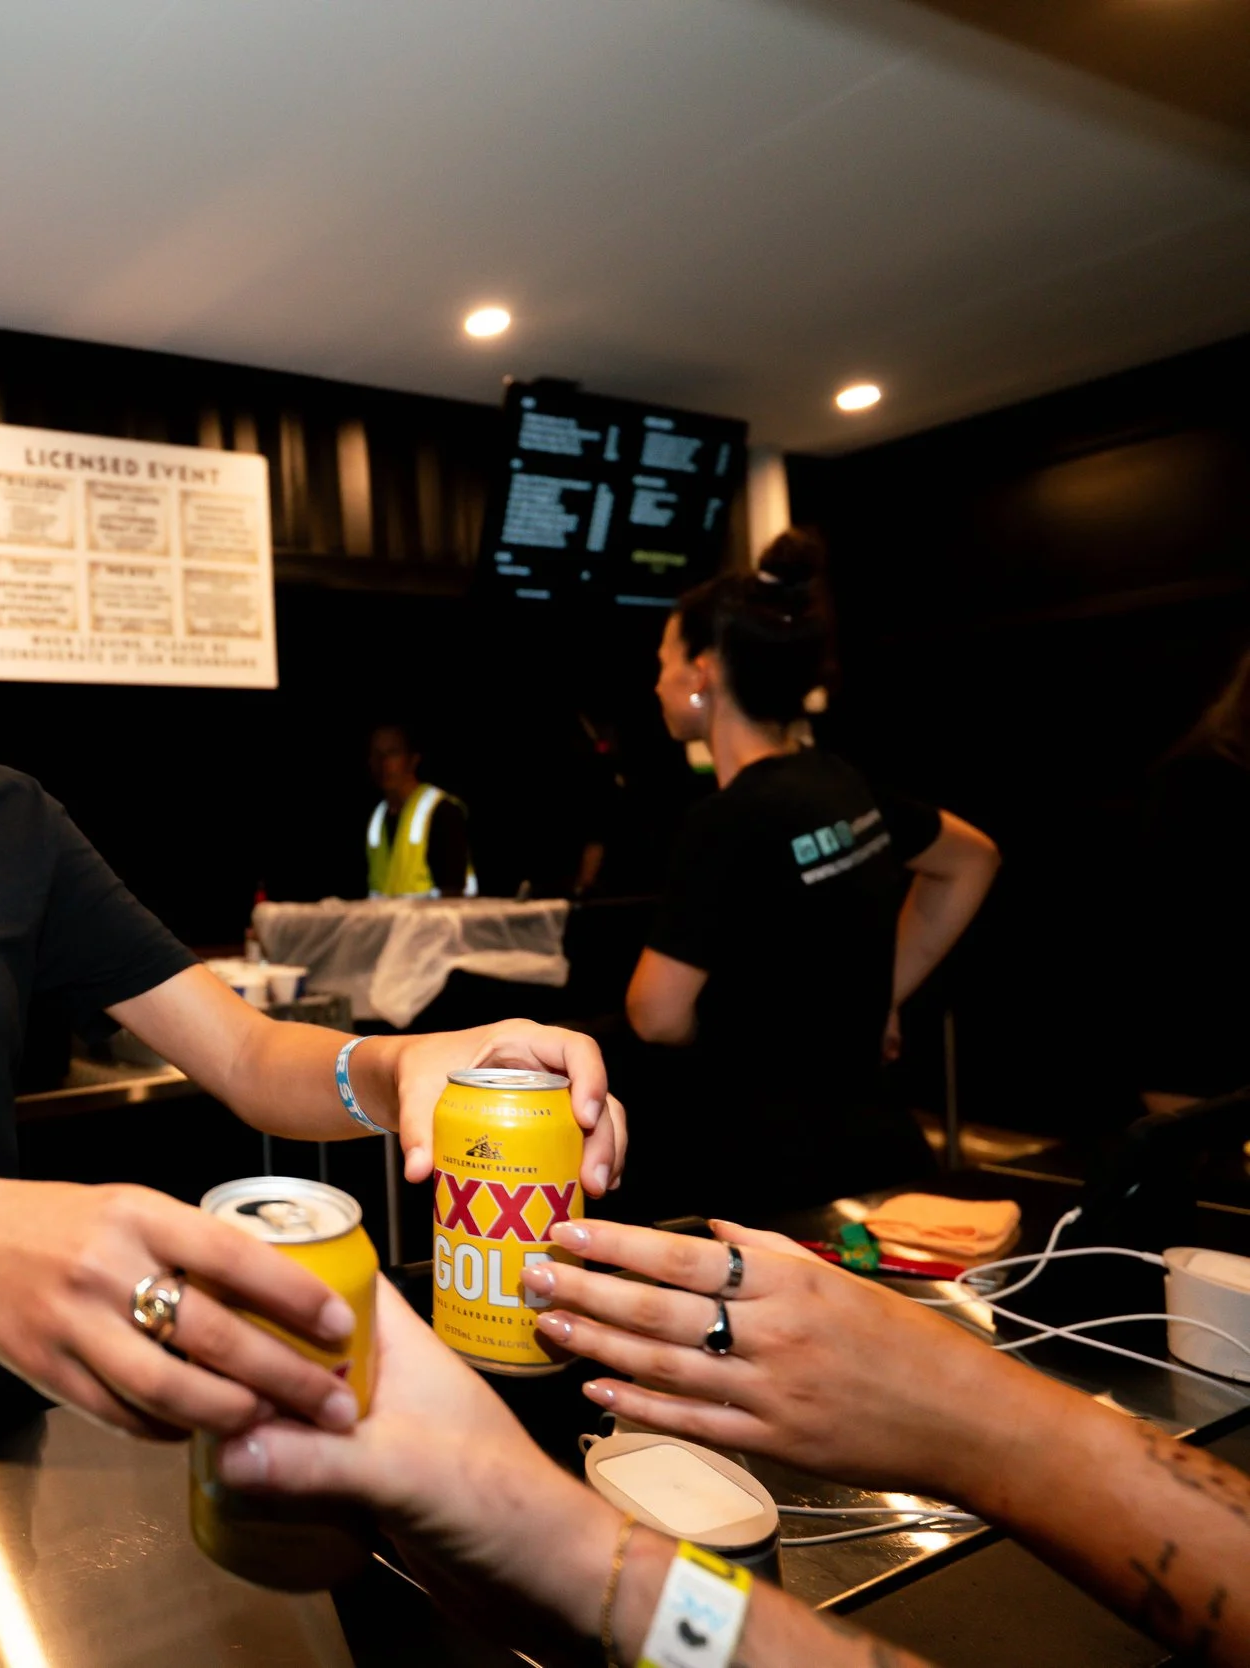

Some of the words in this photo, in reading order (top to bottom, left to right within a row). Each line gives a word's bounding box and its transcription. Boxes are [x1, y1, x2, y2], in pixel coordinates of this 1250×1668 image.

[24, 448, 140, 476] LICENSED
[147, 462, 219, 485] EVENT
[442, 1155, 492, 1171] CASTLEMAINE
[496, 1165, 538, 1174] BREWERY
[452, 1304, 513, 1326] FLAVOURED
